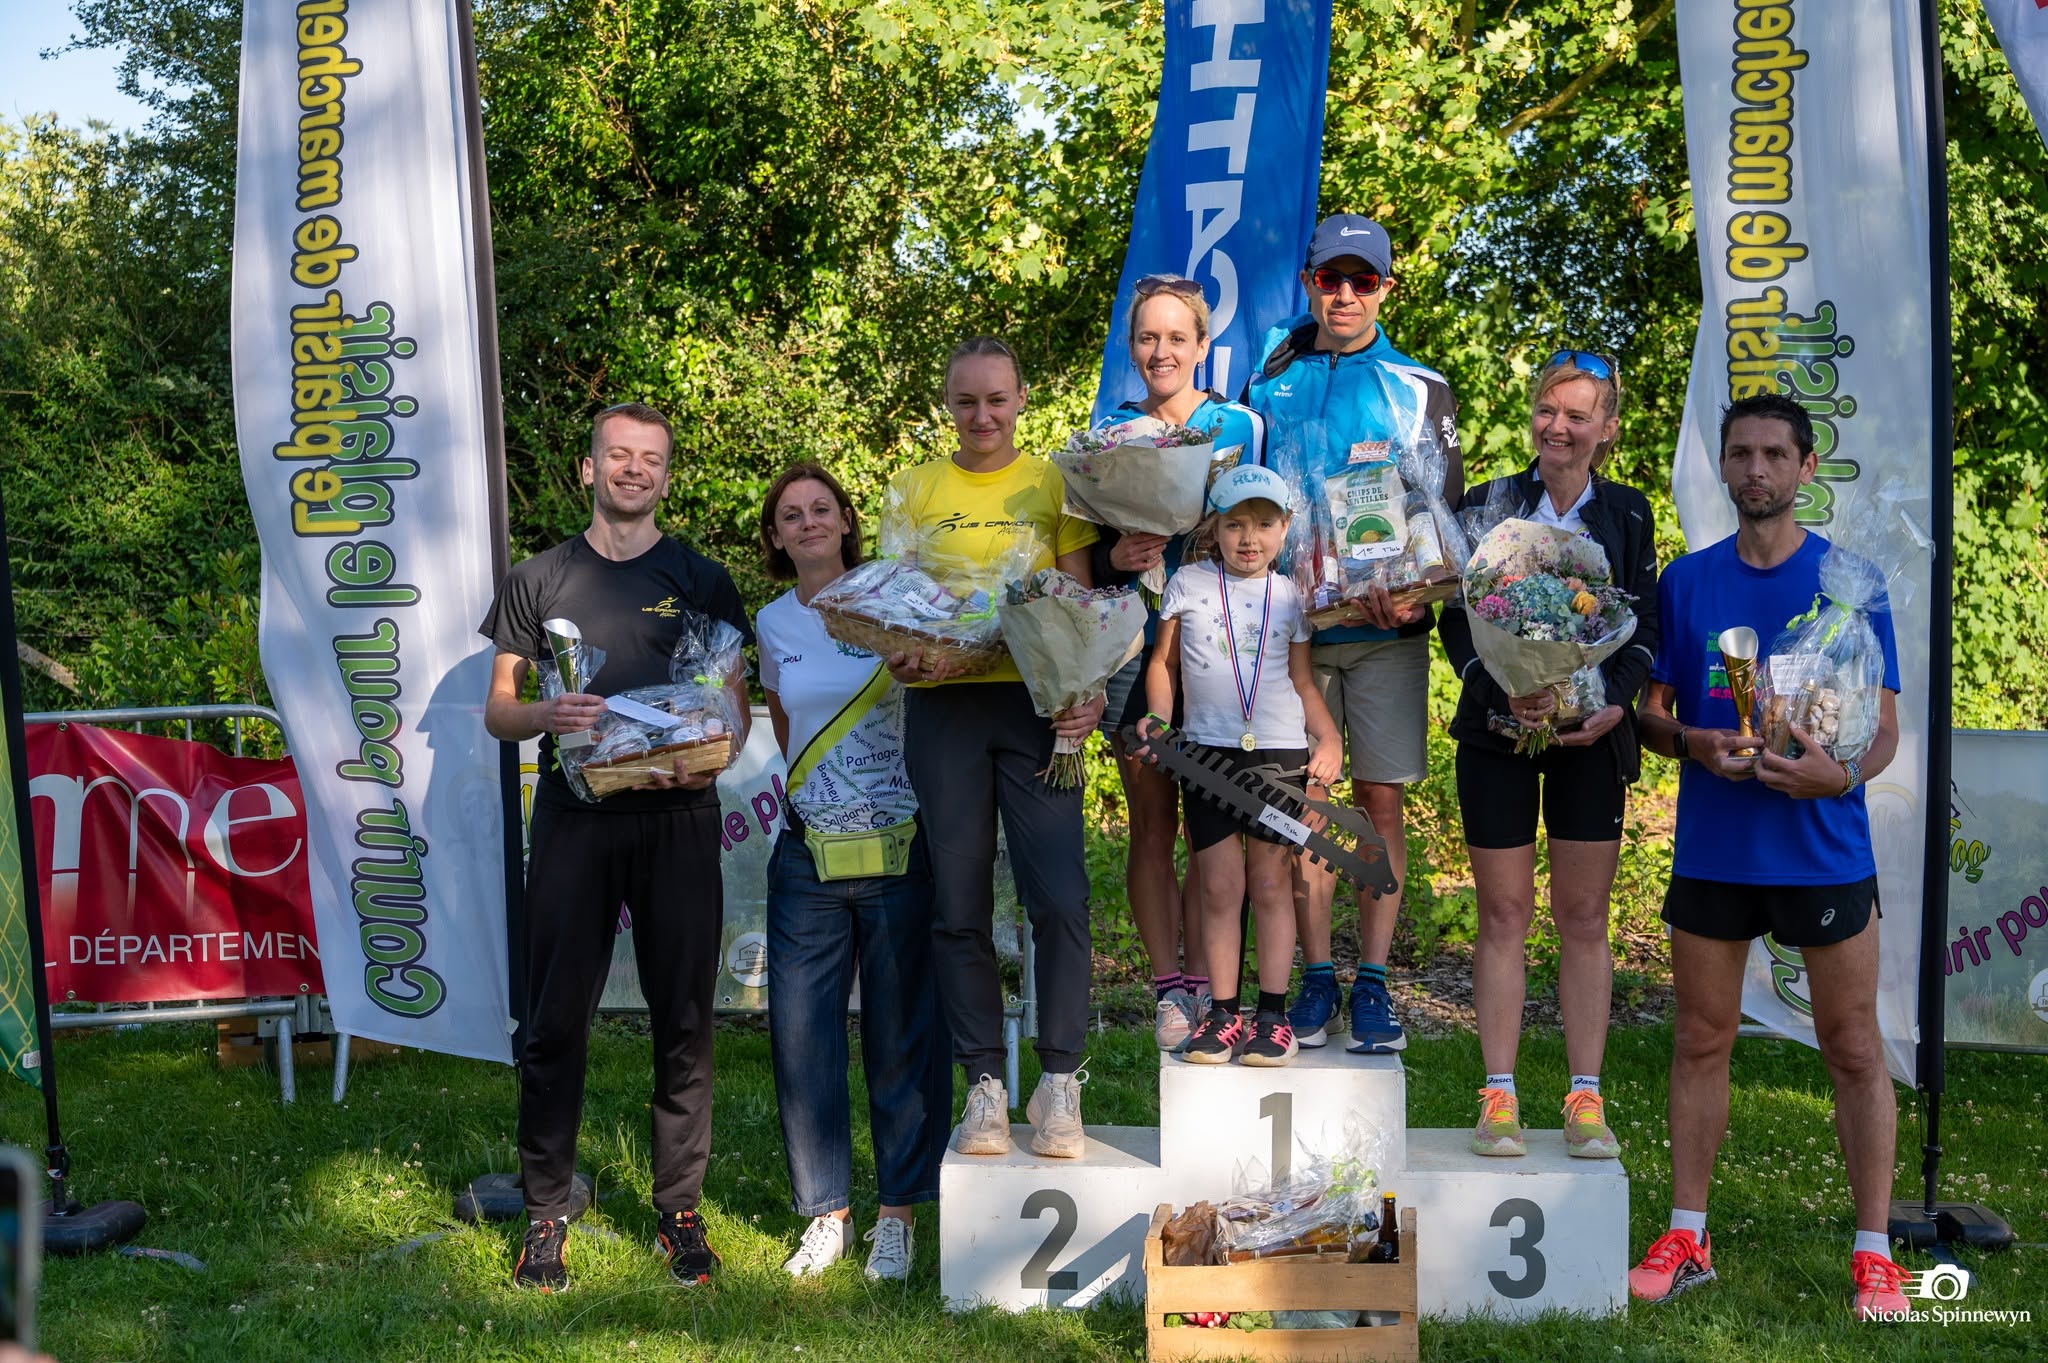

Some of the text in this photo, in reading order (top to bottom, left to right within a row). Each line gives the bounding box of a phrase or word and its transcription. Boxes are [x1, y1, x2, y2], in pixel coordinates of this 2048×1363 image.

[1371, 486, 1383, 494] DE
[846, 748, 900, 769] Partage
[817, 763, 841, 803] Bonheu
[69, 928, 321, 966] DÉPARTEMEN
[1259, 1092, 1293, 1194] 1
[1020, 1189, 1078, 1290] 2
[1488, 1198, 1546, 1299] 3
